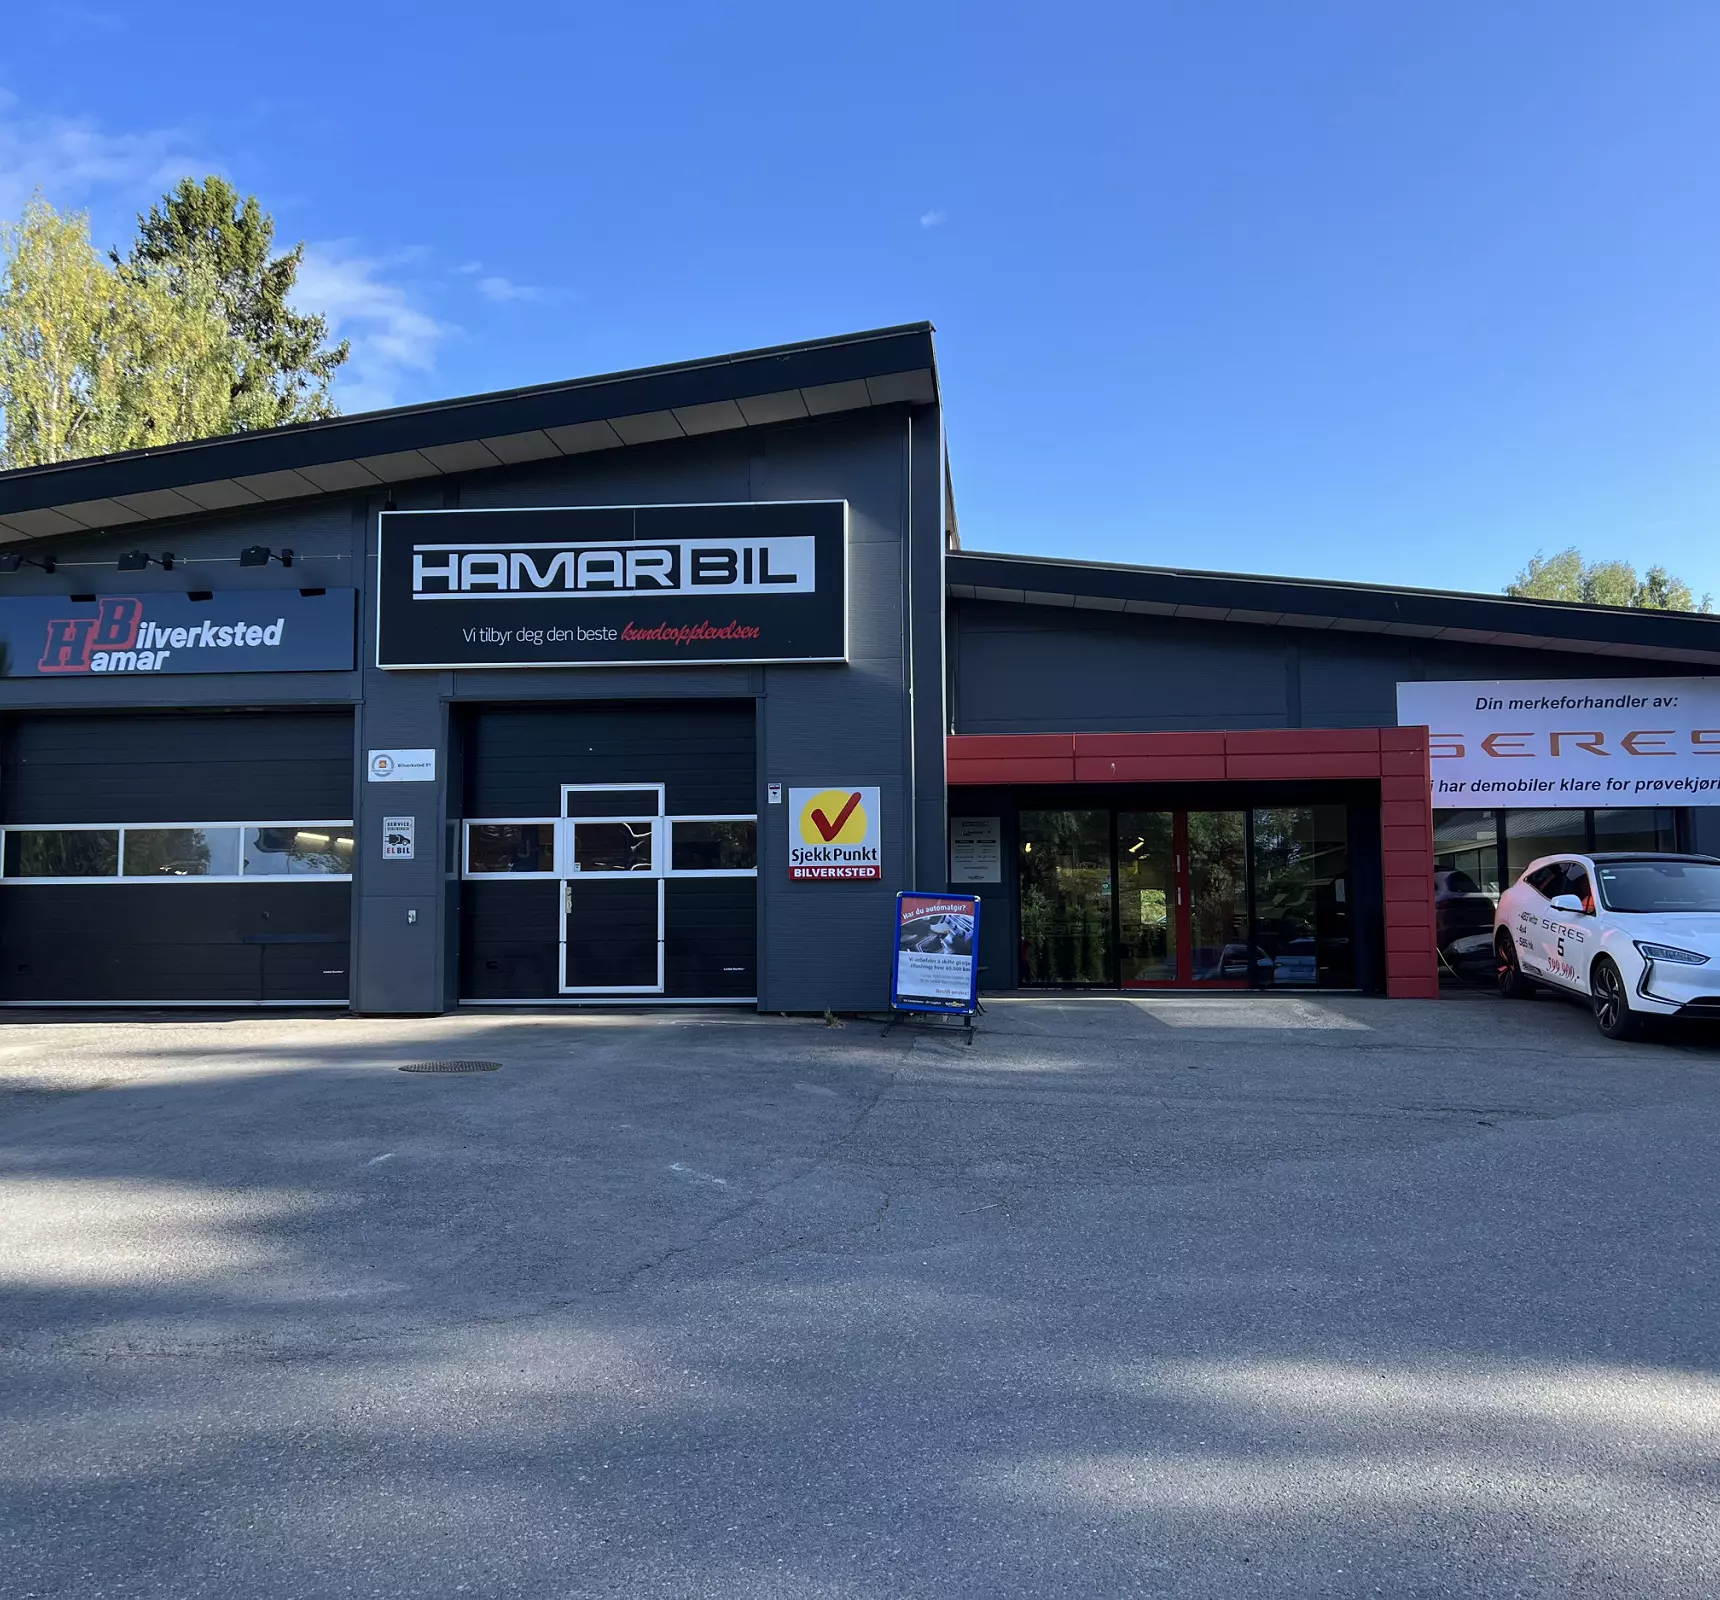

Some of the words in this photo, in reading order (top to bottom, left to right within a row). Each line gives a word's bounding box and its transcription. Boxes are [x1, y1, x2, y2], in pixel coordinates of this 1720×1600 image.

[412, 548, 675, 592] HAMAR
[690, 546, 798, 586] BIL
[462, 627, 476, 642] Vi
[479, 626, 513, 646] tilbyr
[516, 626, 544, 646] deg
[546, 626, 574, 642] den
[577, 625, 618, 642] beste
[620, 619, 760, 646] kundeopplevelsen
[1475, 696, 1503, 710] Din
[1508, 695, 1648, 710] merkeforhandler
[1653, 695, 1679, 708] av:
[1438, 779, 1466, 793] har
[1470, 778, 1556, 793] demobiler
[1560, 778, 1601, 792] klare
[1606, 777, 1631, 791] for
[793, 867, 876, 878] BILVERKSTED
[902, 911, 914, 920] Har
[915, 907, 925, 915] du
[925, 904, 967, 913] automatgir?
[1541, 919, 1585, 943] SERES
[1557, 937, 1565, 957] 5
